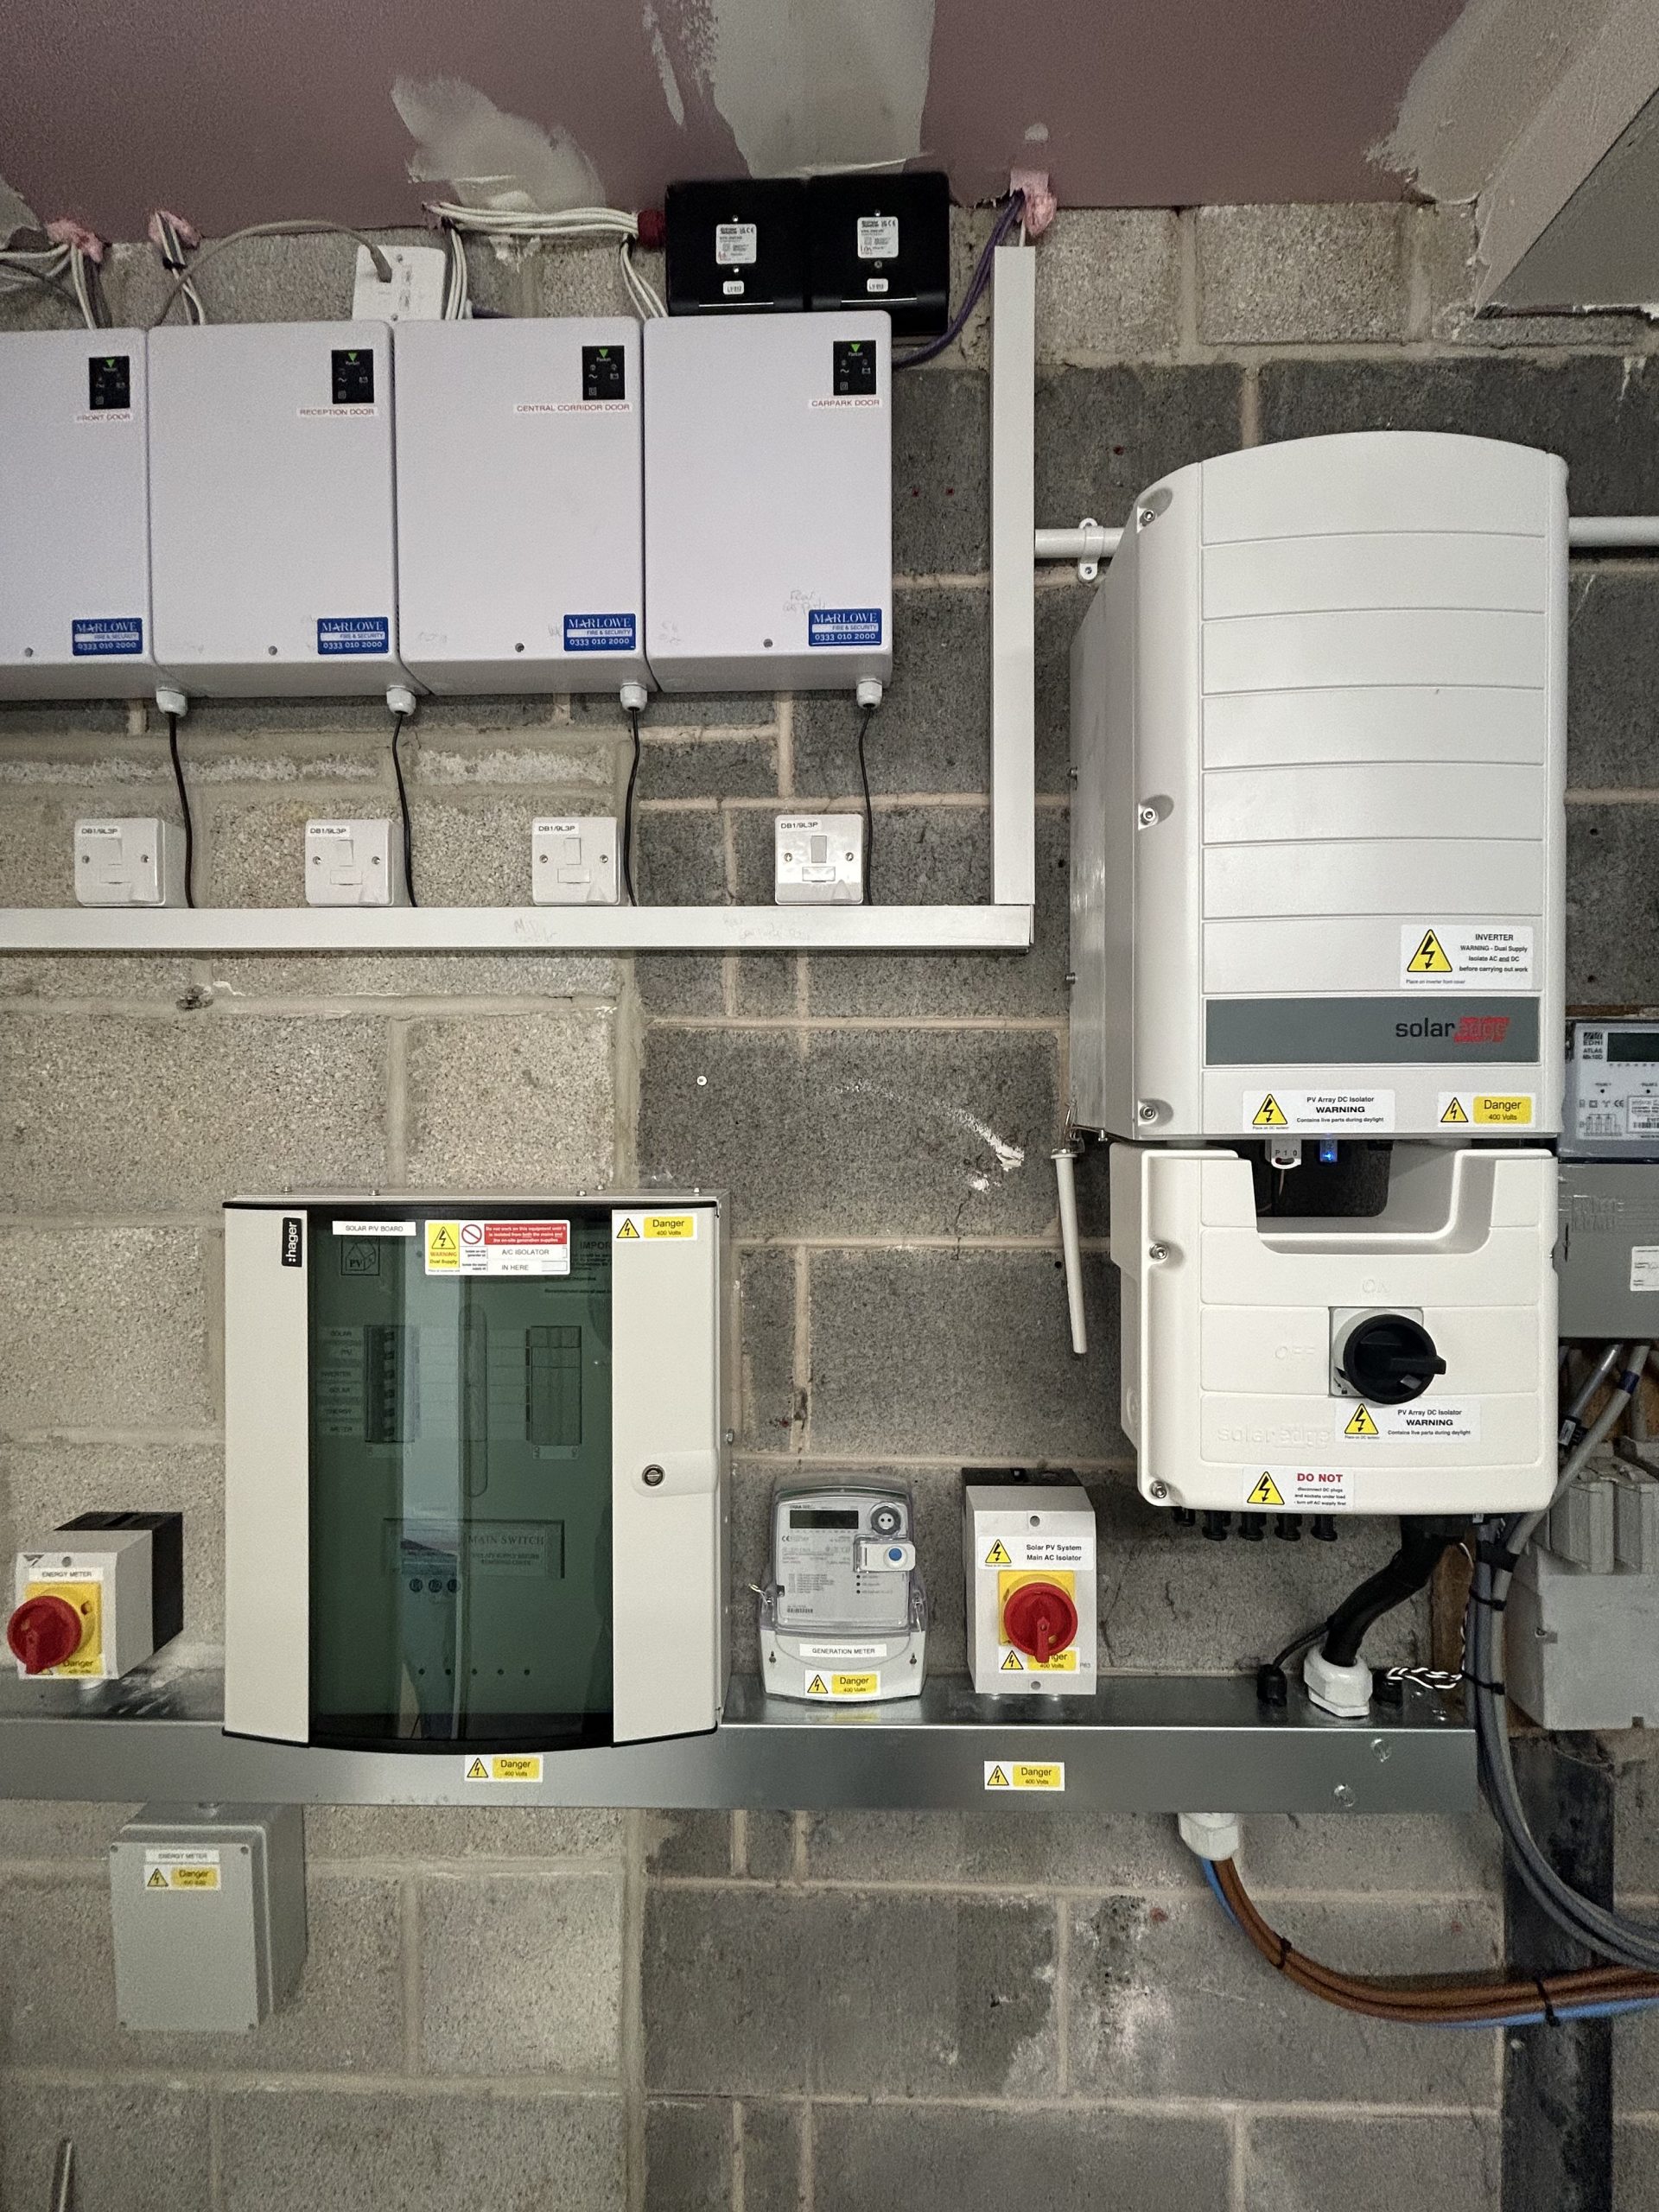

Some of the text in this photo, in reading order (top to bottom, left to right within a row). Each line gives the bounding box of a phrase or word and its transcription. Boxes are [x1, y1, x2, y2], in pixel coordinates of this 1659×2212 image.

[569, 618, 631, 628] MARLOWE
[814, 613, 877, 623] MARLOWE
[76, 621, 137, 632] MARLOWE
[321, 621, 384, 632] MARLOWE
[1484, 1099, 1522, 1111] Danger
[652, 1219, 685, 1229] Danger
[349, 1259, 362, 1268] PV
[1297, 1473, 1343, 1483] DO NOT
[500, 1535, 544, 1545] SWITCH
[62, 1659, 94, 1669] Danger
[839, 1676, 869, 1686] Danger
[500, 1759, 531, 1770] Danger
[1020, 1767, 1052, 1777] Danger
[179, 1870, 209, 1878] Danger
